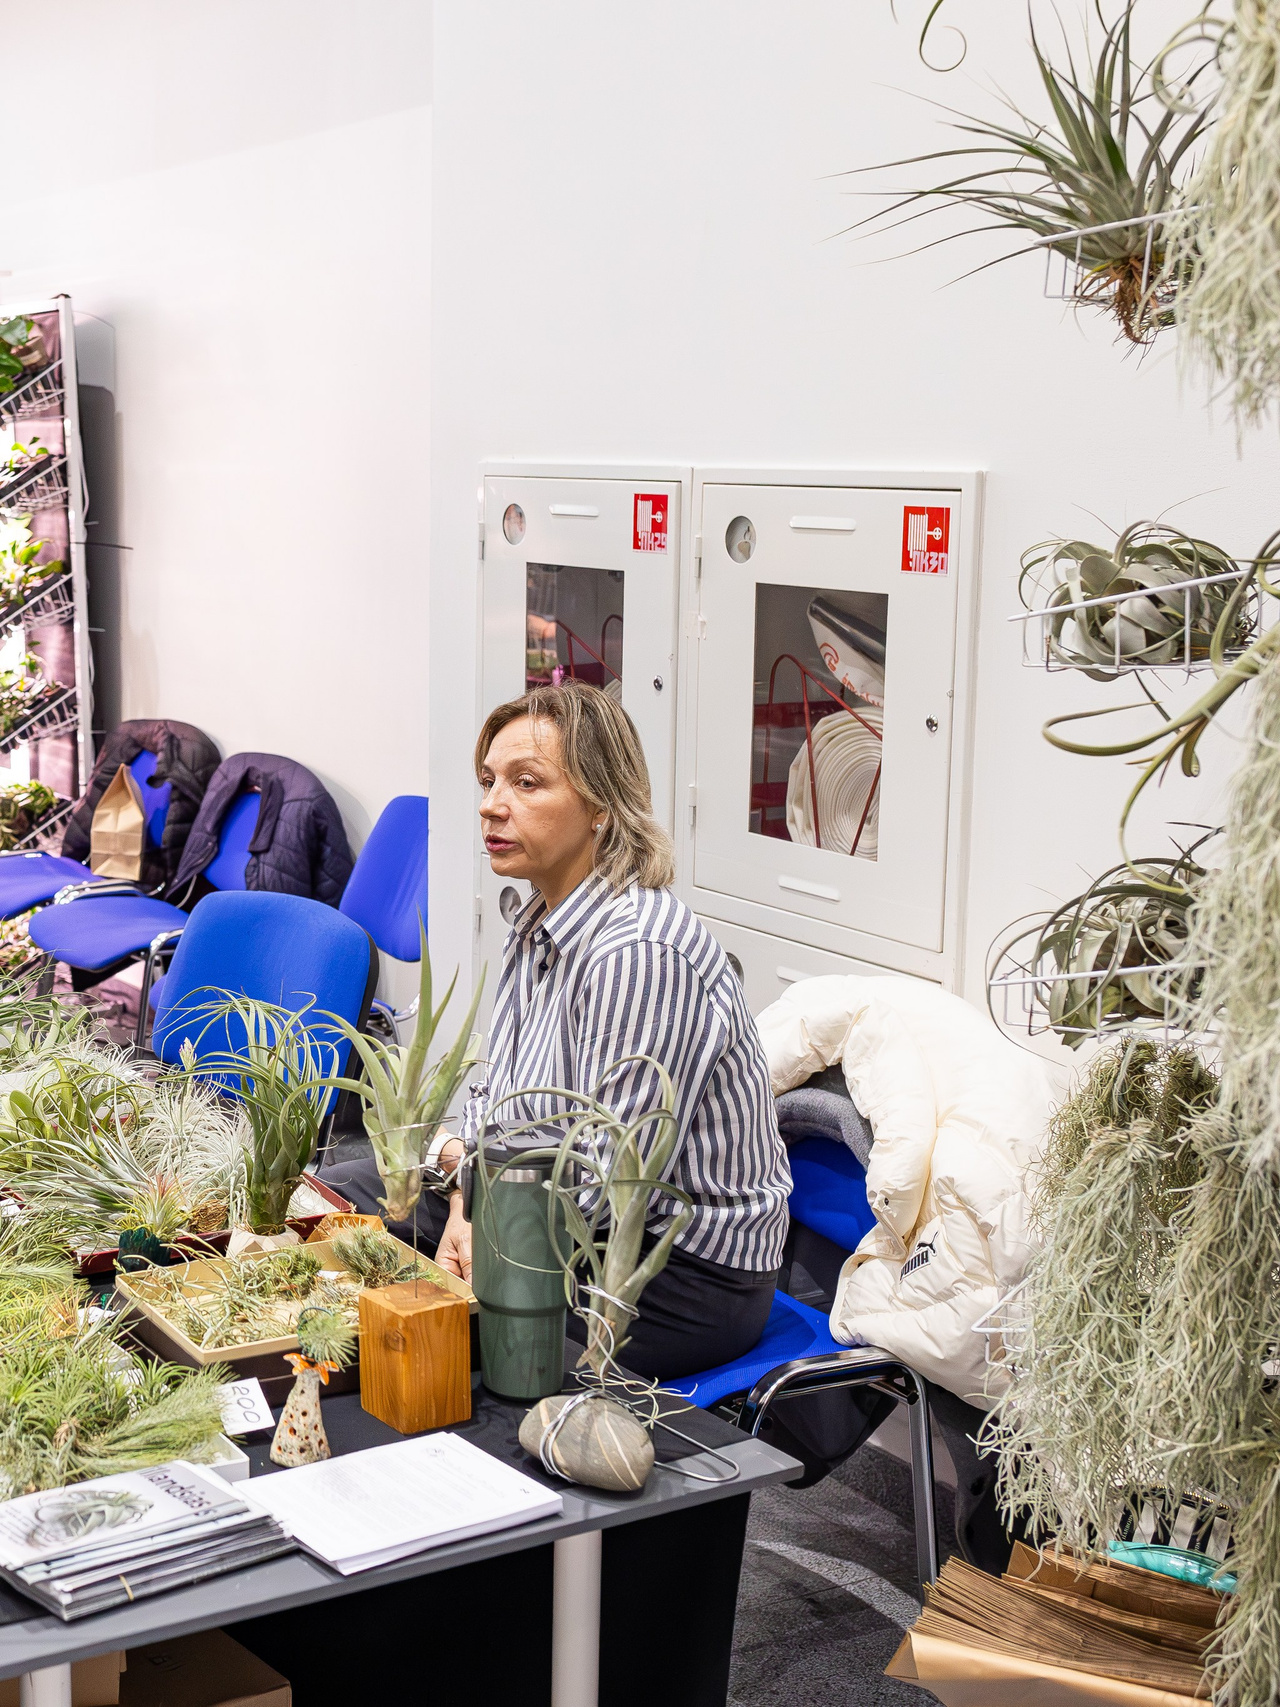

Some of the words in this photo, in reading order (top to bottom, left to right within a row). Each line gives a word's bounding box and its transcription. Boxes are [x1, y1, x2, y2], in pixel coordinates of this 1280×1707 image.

[899, 1250, 930, 1281] PUMA
[231, 1386, 261, 1423] 200
[137, 1466, 211, 1508] illandsias
